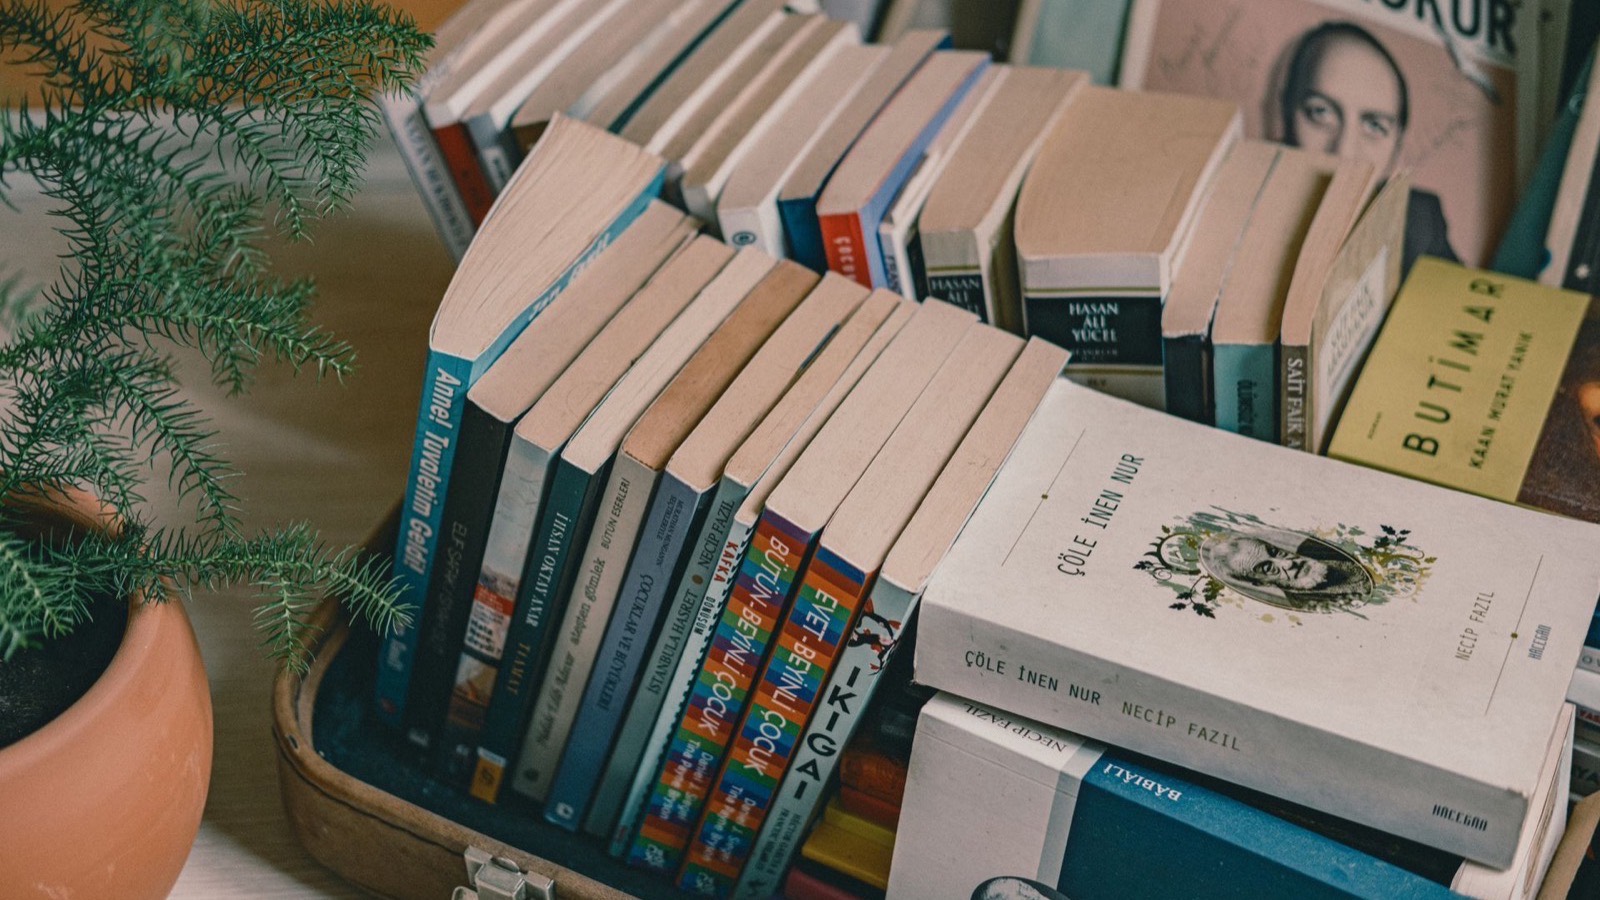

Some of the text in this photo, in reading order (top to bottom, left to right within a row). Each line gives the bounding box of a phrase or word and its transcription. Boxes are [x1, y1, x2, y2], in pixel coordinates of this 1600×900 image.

[1069, 302, 1119, 315] HASAN
[430, 367, 461, 428] Anne!
[1287, 357, 1303, 396] SAİT
[1403, 278, 1504, 457] BUTİMAR
[1469, 425, 1495, 469] KAAN
[1489, 375, 1515, 421] MURAT
[412, 430, 449, 517] Tuvaletim
[547, 512, 572, 555] İHSAN
[600, 477, 631, 549] BÜTÜN ESERLERİ
[1057, 453, 1145, 577] ÇÖLE İNEN NUR
[534, 555, 556, 598] OKTAY
[584, 558, 606, 602] gömlek
[714, 541, 739, 583] KAFKA
[525, 595, 545, 628] ANAR
[627, 573, 655, 632] ÇOCUKLAR
[648, 499, 735, 696] İSTANBULA HASRET NECİP FAZIL
[1455, 591, 1494, 661] NECİP FAZIL
[619, 630, 632, 652] VE
[698, 669, 737, 736] ÇOCUK
[963, 702, 1067, 753] NECİP FAZIL
[965, 650, 1241, 752] ÇÖLE İNEN NUR NECİP FAZIL
[743, 708, 786, 777] ÇOCUK
[793, 666, 861, 800] IKIGAI
[1103, 763, 1182, 802] BÂBIÂLİ
